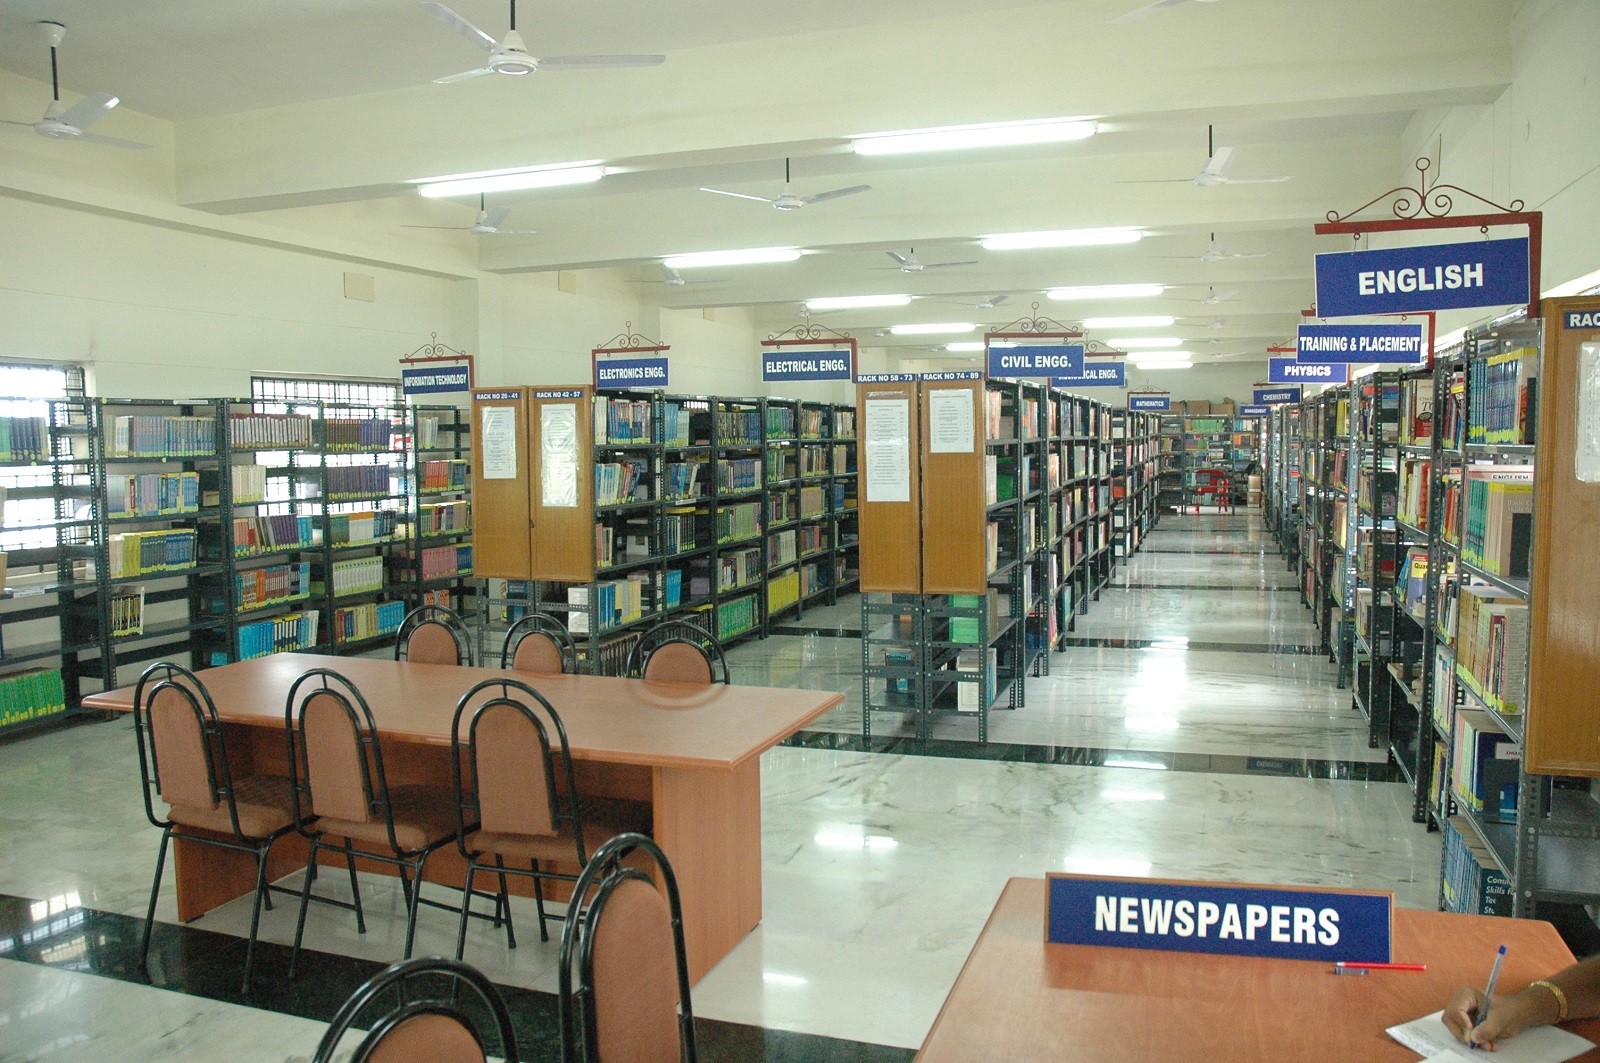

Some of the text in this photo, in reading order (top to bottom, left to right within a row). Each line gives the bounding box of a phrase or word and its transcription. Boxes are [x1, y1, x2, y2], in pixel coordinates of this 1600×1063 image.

[1359, 263, 1484, 295] ENGLISH
[1300, 336, 1420, 352] TRAINING & PLACEMENT
[766, 359, 847, 373] ELECTRICAL ENGG.
[1001, 355, 1072, 368] CIVIL ENGG.
[600, 366, 666, 380] ELECTRONICS ENGG.
[1099, 369, 1118, 379] ENGG.
[1284, 363, 1331, 377] PHYSICS
[404, 373, 467, 387] INFORMATION TECHNOLOGY
[1262, 393, 1291, 401] CHEMISTRY
[1486, 886, 1505, 895] Skills
[1094, 896, 1341, 946] NEWSPAPERS
